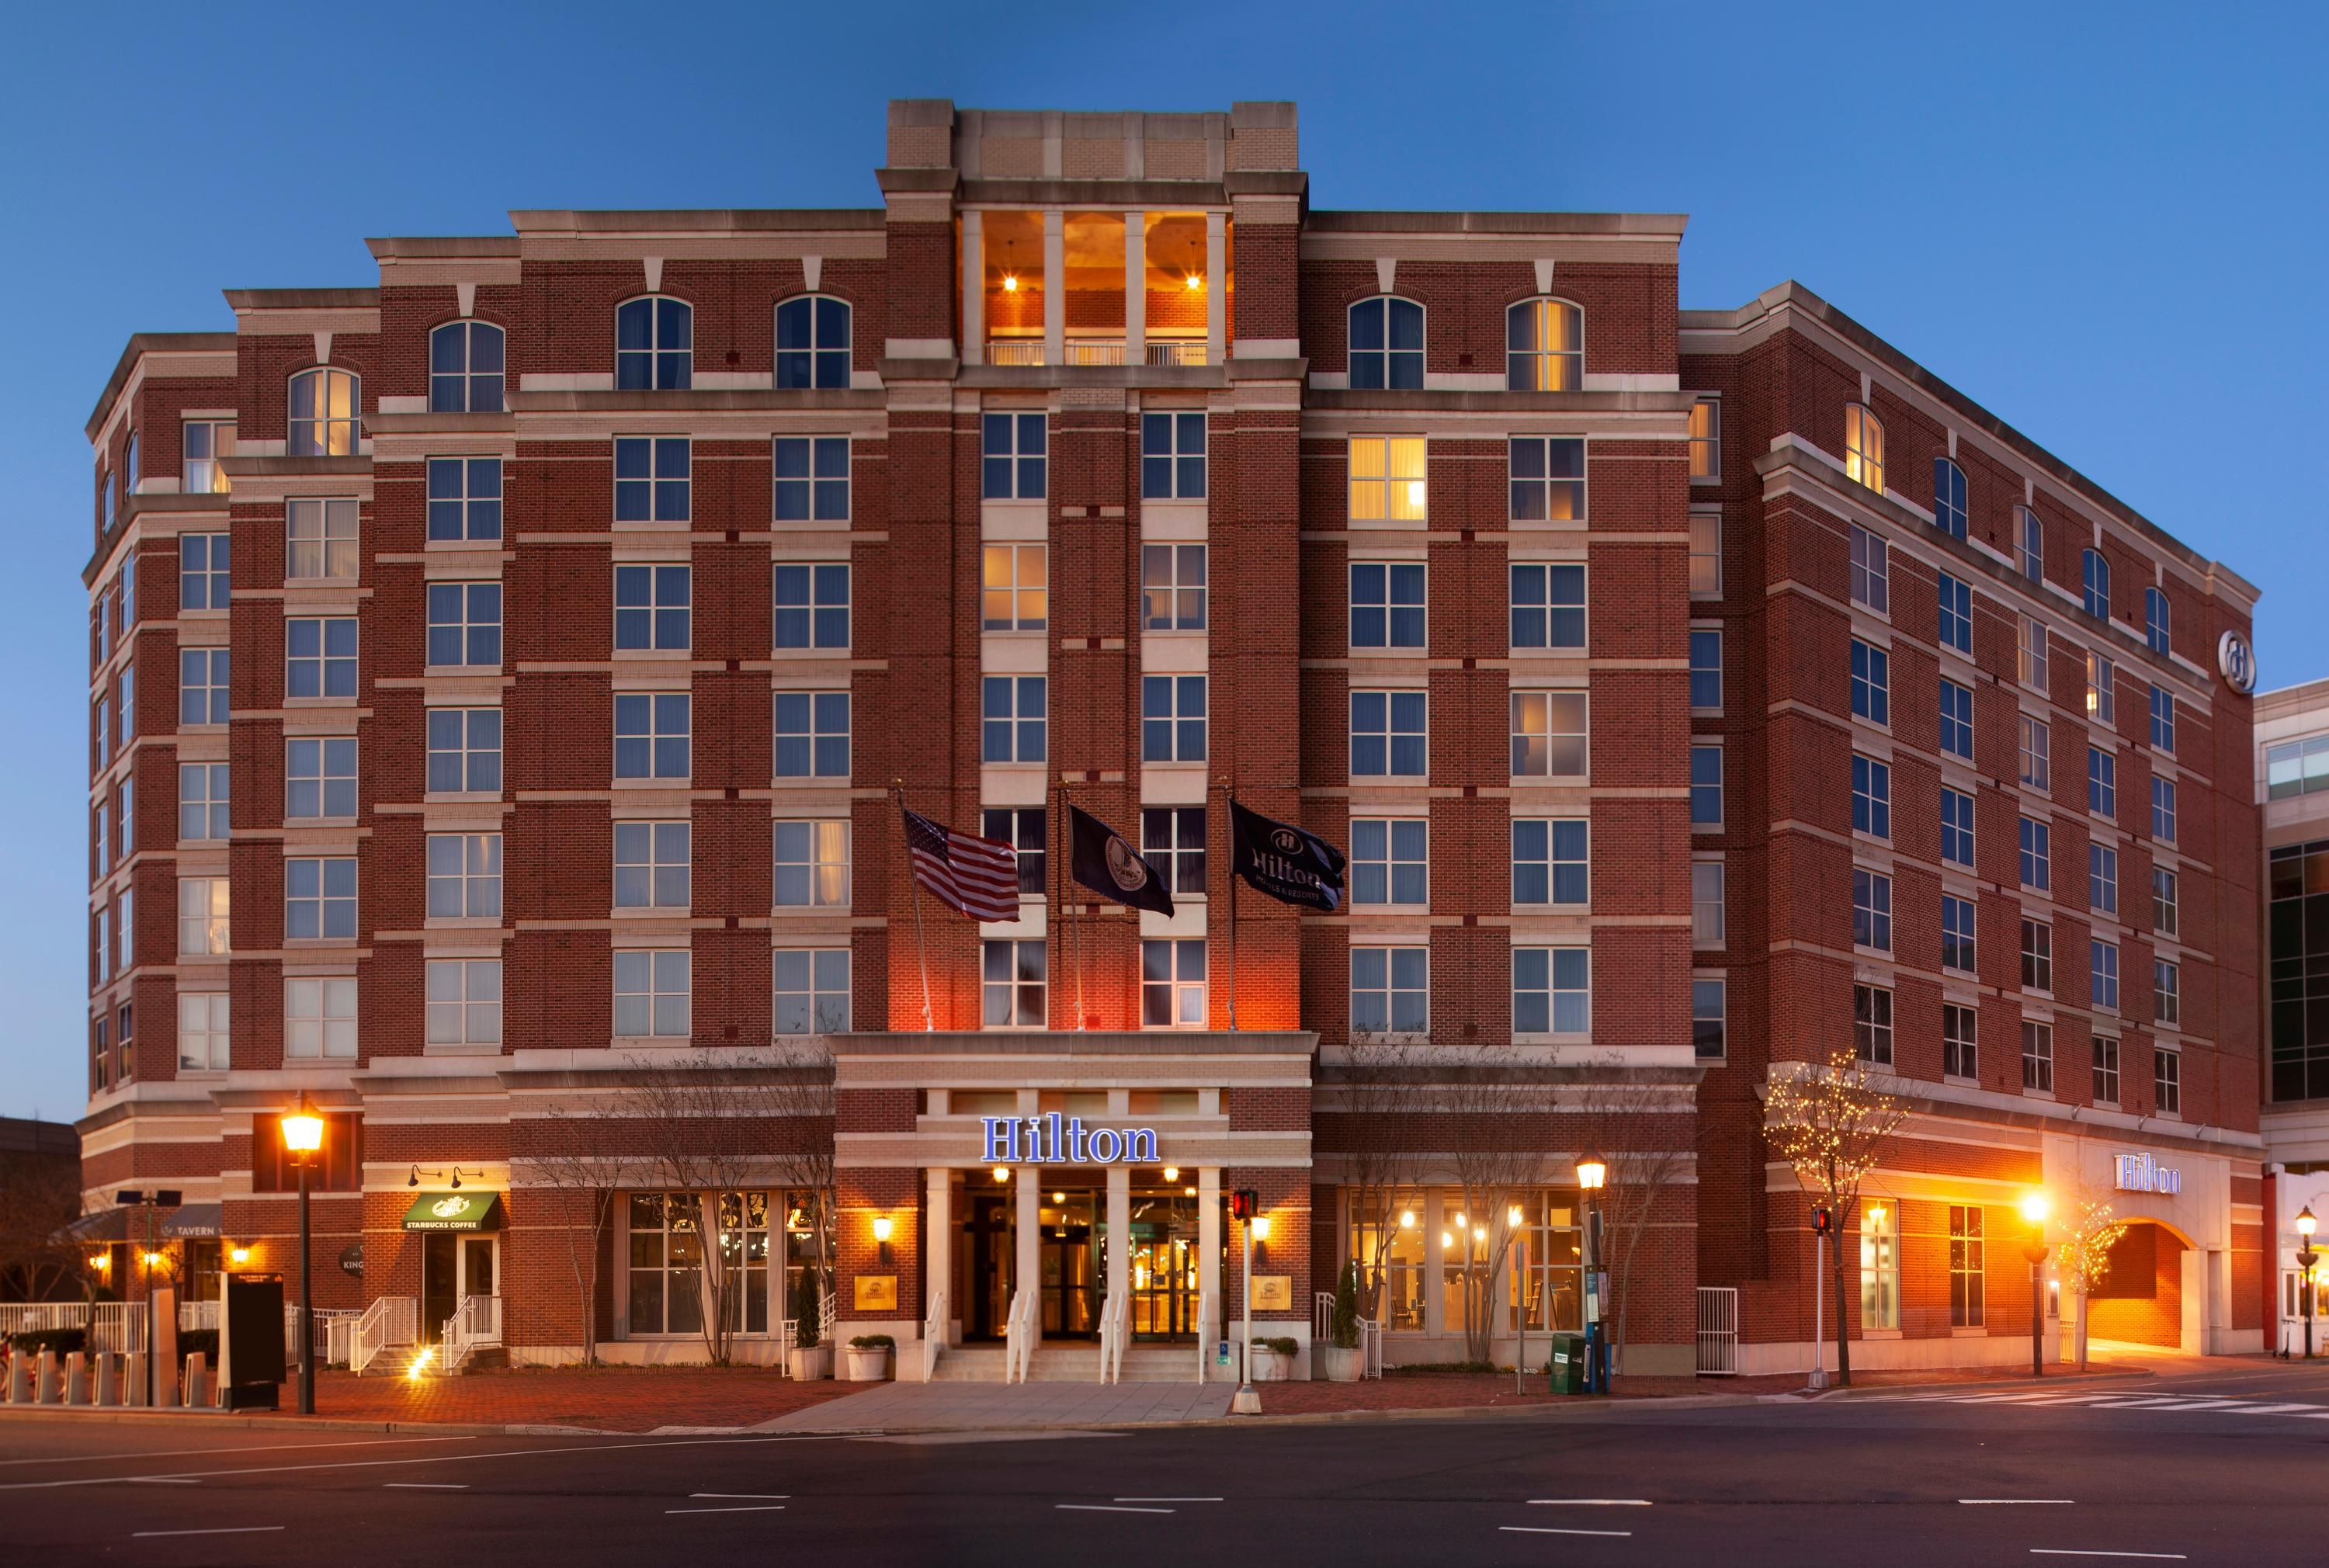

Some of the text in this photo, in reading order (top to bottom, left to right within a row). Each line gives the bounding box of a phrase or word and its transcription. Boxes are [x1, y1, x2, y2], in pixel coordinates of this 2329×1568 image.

[1252, 848, 1321, 890] Hilton
[1289, 889, 1320, 900] RESORTS
[981, 1112, 1161, 1163] Hilton
[2115, 1153, 2181, 1194] Hilton
[177, 1226, 215, 1236] TAVERN
